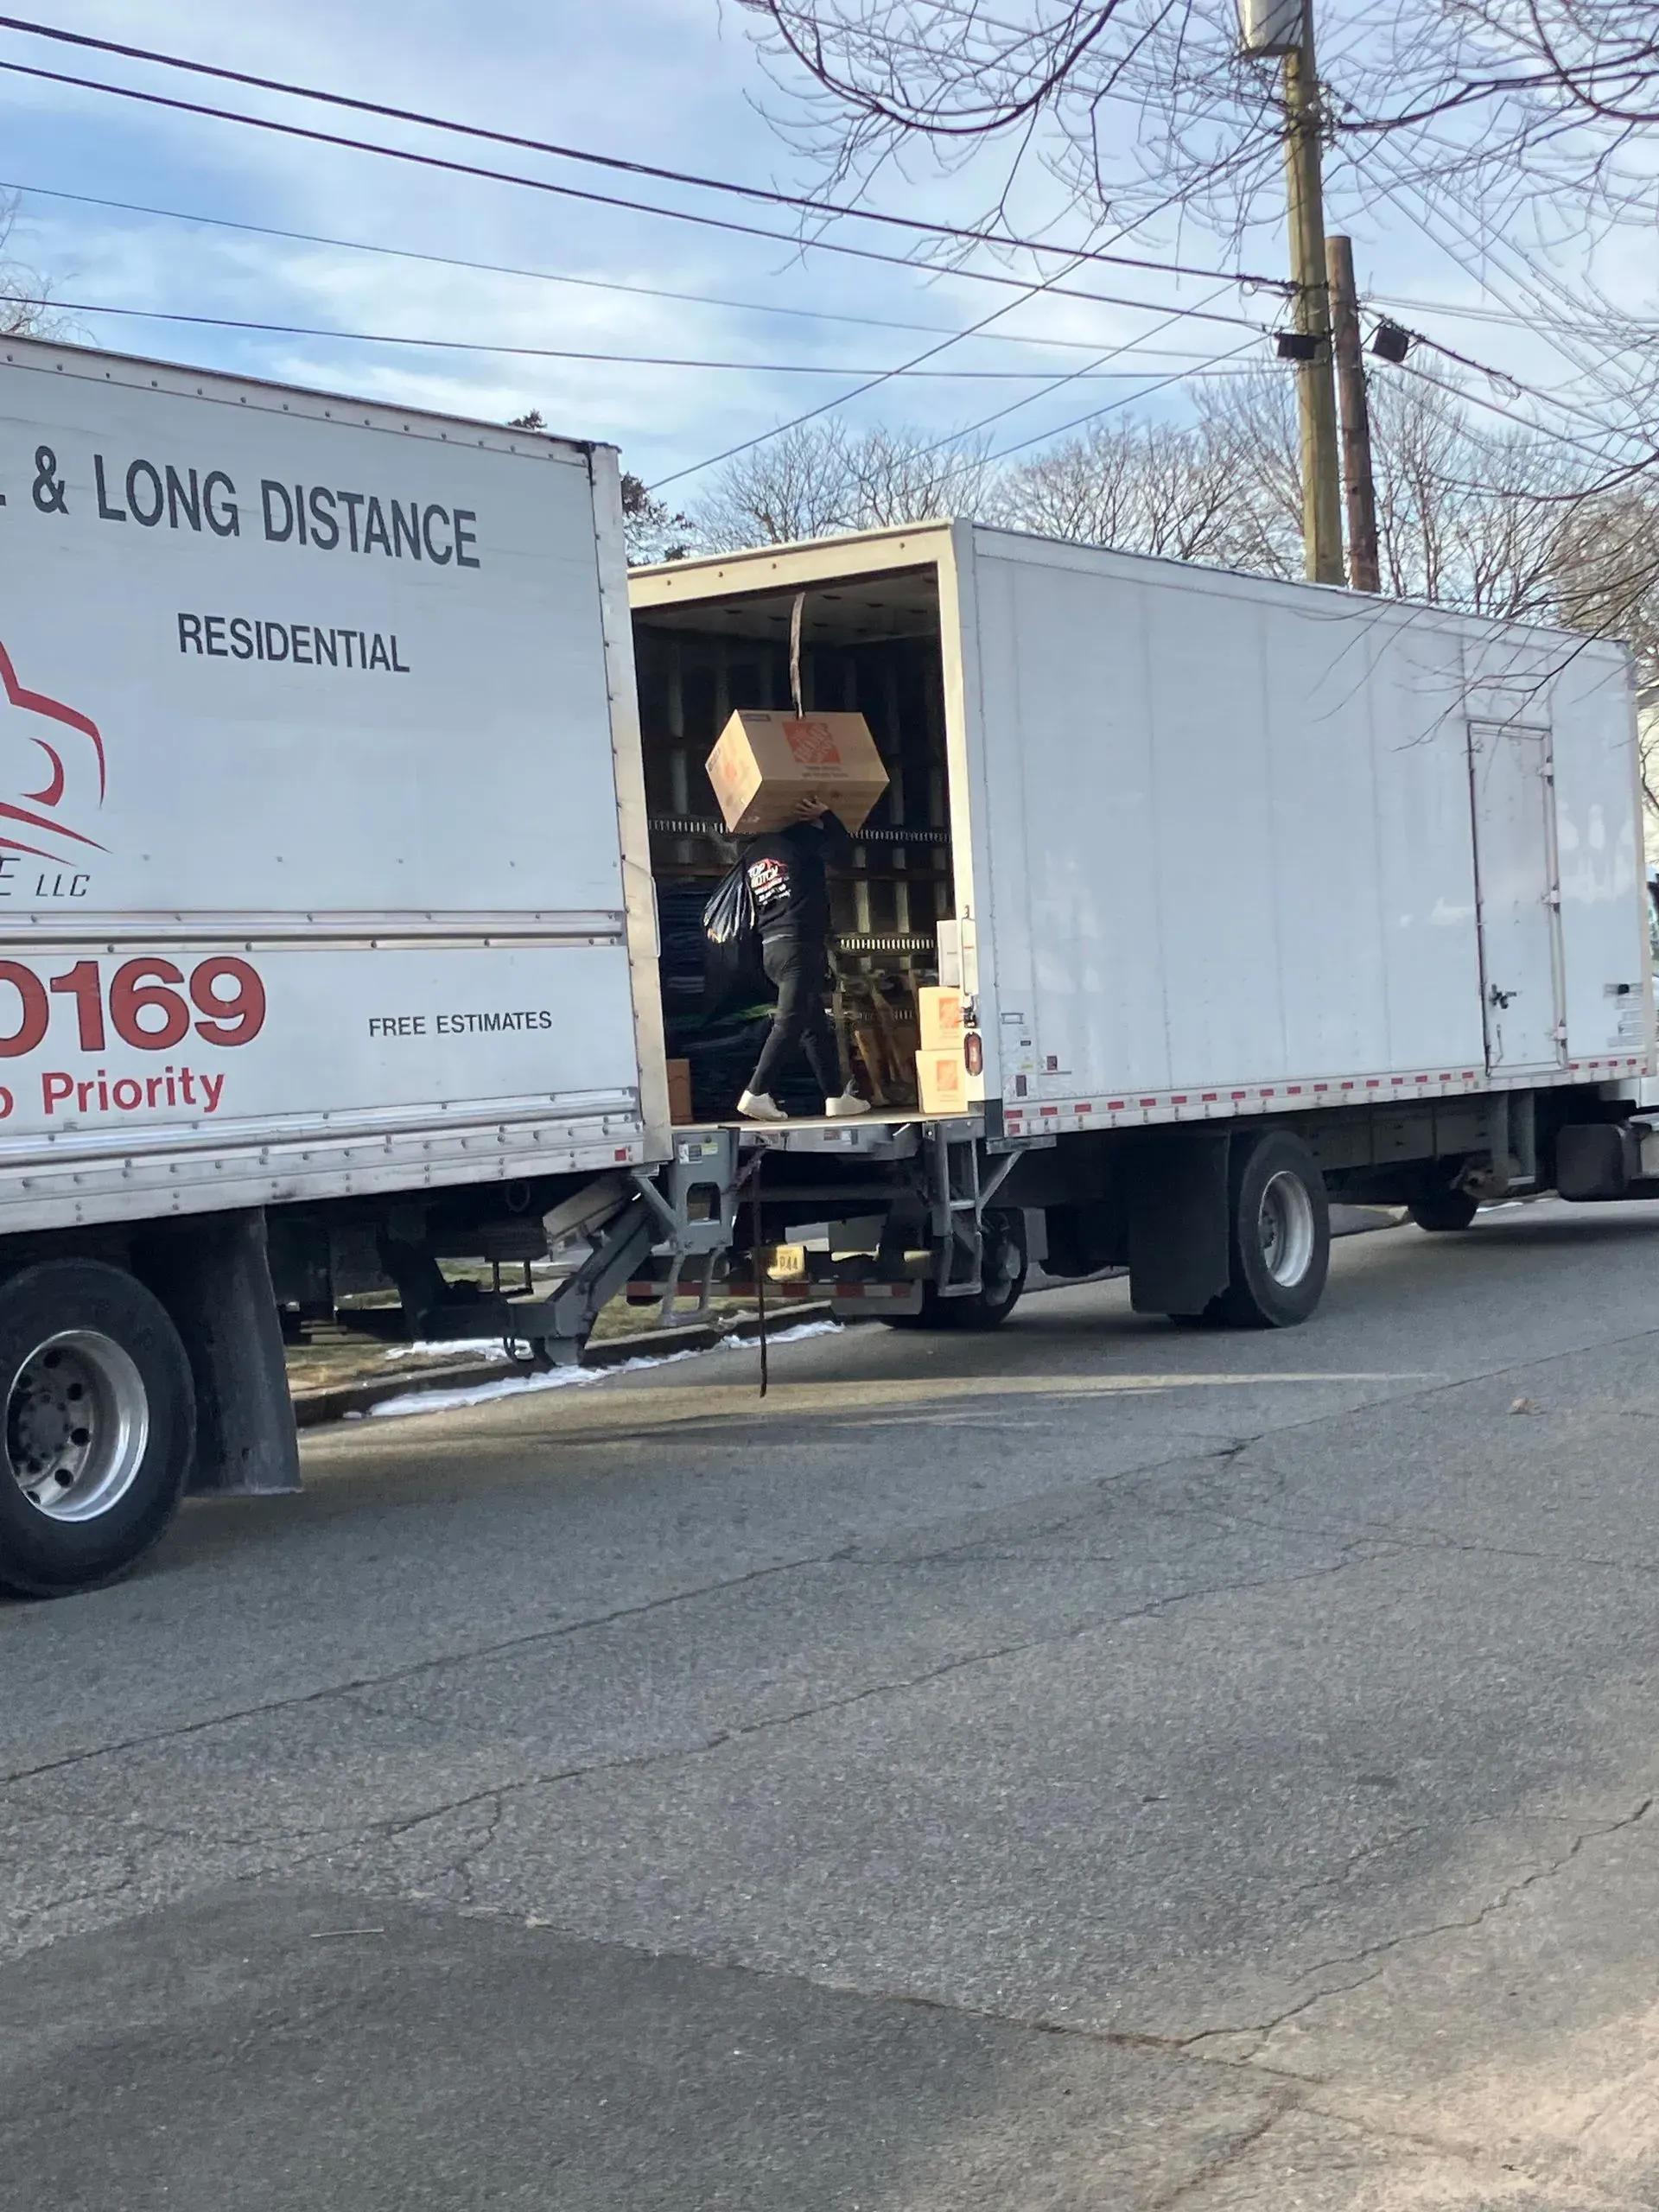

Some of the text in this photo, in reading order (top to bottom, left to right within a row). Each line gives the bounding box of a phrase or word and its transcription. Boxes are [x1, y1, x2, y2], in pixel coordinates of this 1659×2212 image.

[33, 445, 480, 568] & LONG DISTANCE
[178, 613, 410, 672] RESIDENTIAL
[35, 874, 91, 897] LLC
[369, 1011, 552, 1037] FREE ESTIMATES
[41, 1065, 225, 1115] Priority
